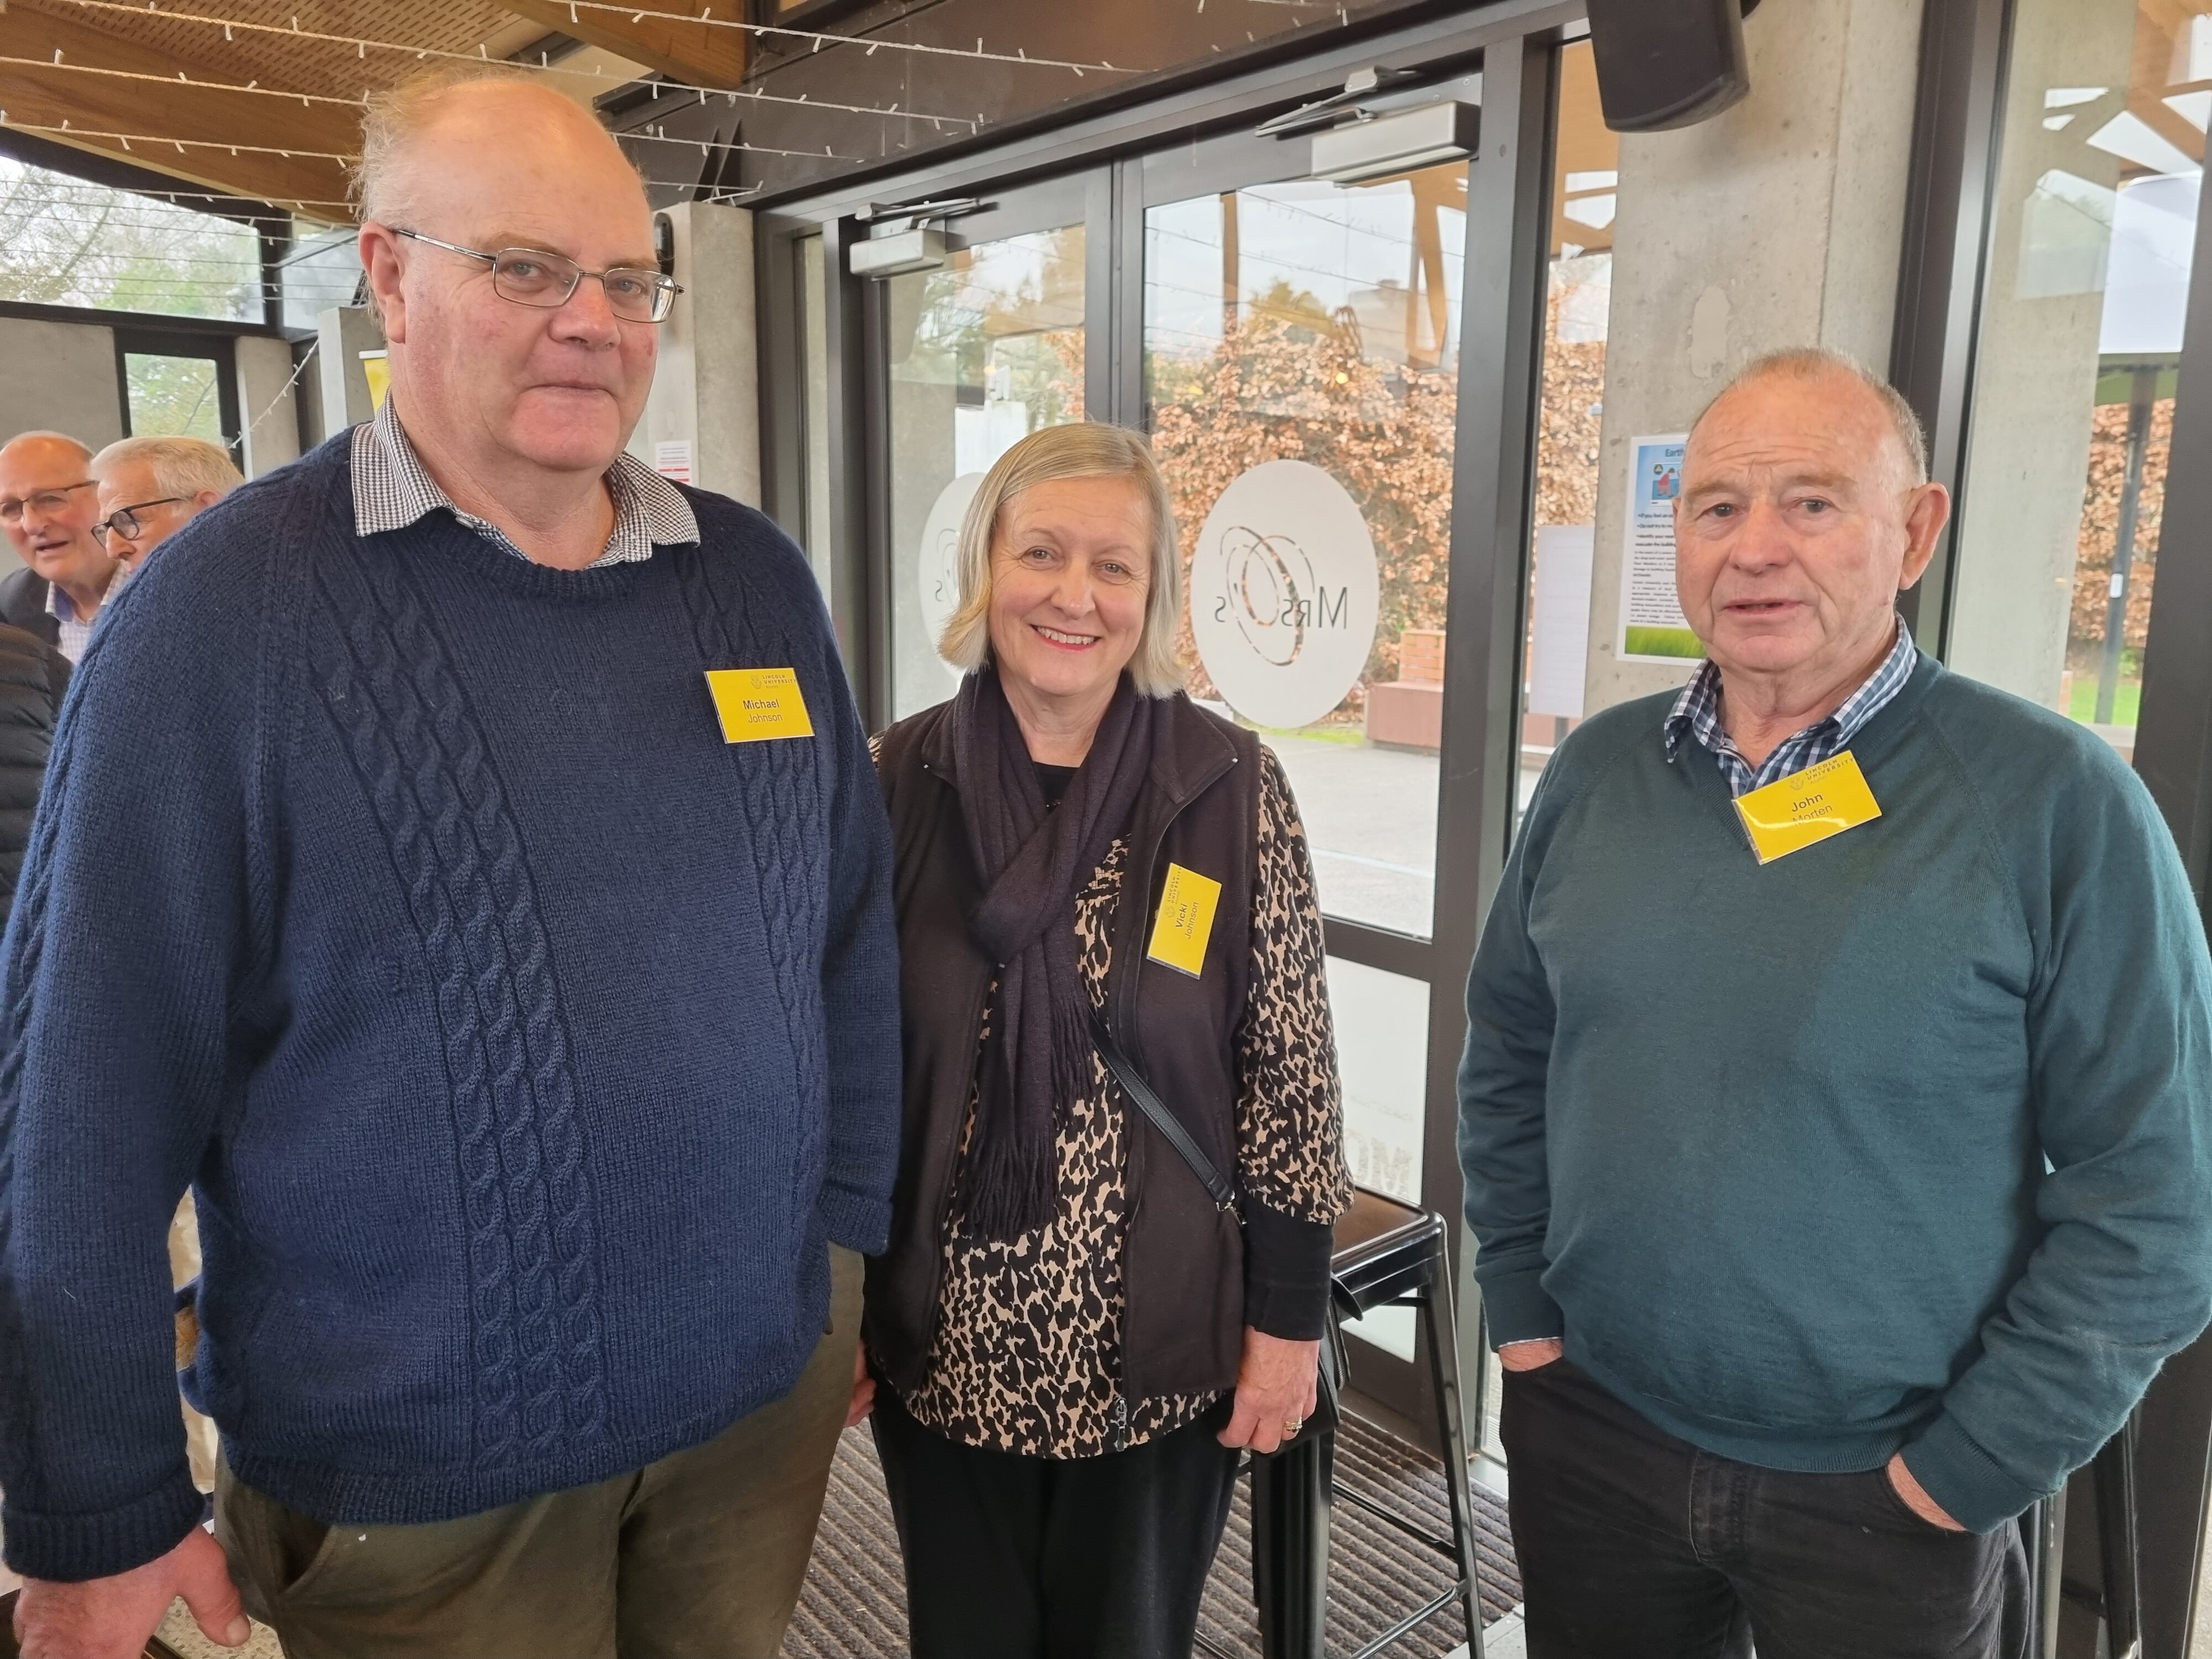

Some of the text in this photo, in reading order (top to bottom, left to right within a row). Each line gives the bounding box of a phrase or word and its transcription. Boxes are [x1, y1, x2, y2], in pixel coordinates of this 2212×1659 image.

[743, 698, 780, 710] Michael
[748, 713, 783, 723] Johnson
[1805, 759, 1837, 775] LINCOLN
[1807, 757, 1854, 780] UNIVERSITY
[1792, 794, 1823, 812] John
[1167, 877, 1176, 902] LINCOLN
[1171, 867, 1181, 903] UNIVERSITY
[1175, 902, 1188, 927] Vicki
[1184, 901, 1199, 940] Johnson
